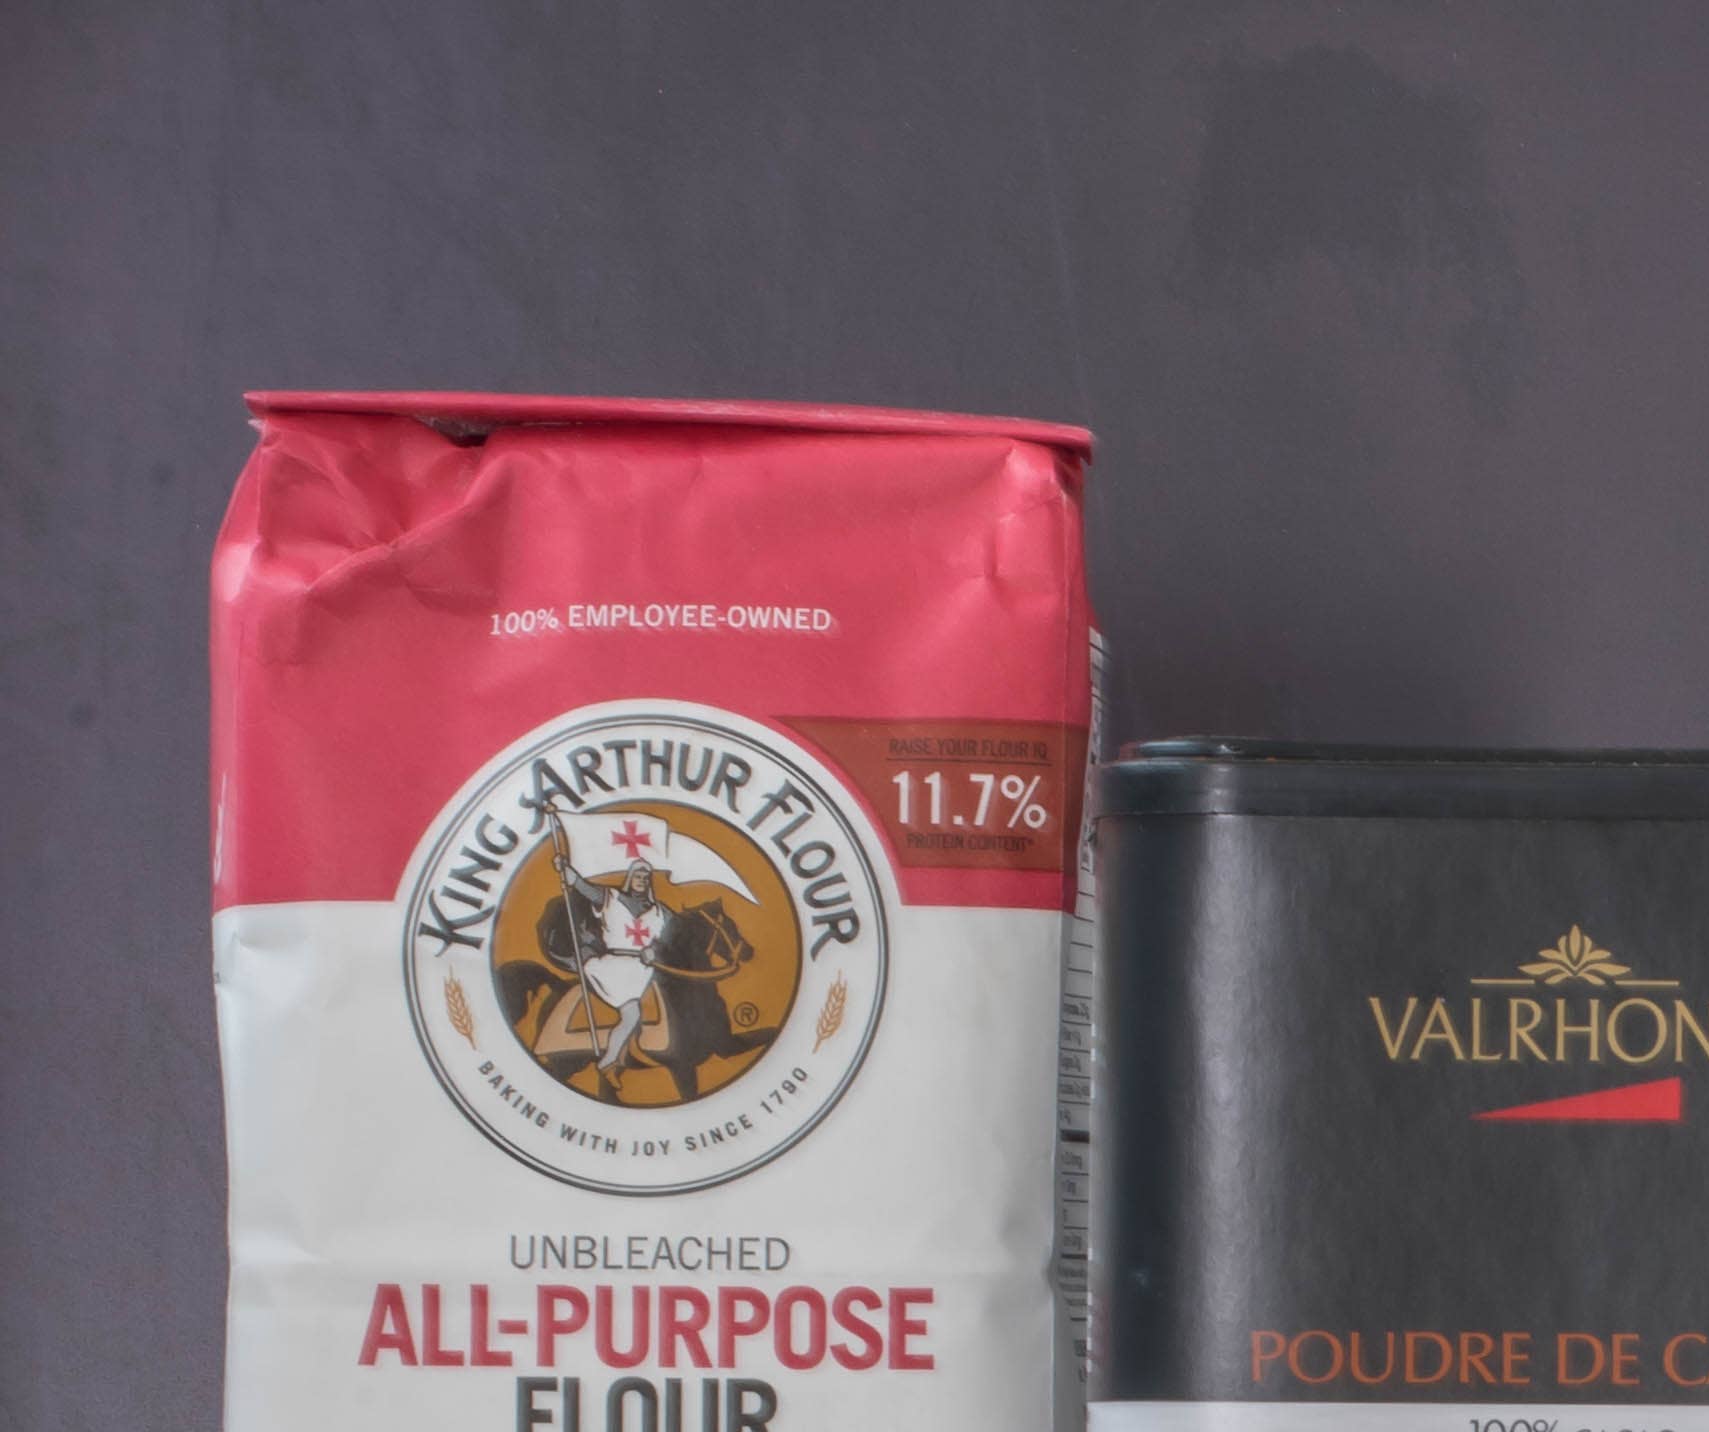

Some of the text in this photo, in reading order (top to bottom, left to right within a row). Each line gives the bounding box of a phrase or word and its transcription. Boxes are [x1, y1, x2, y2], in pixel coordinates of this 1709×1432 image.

[490, 605, 832, 636] 100% EMPLOYEE-OWNED
[892, 771, 1047, 829] 11.7%
[418, 738, 860, 962] KING ARTHUR FLOUR
[477, 1059, 811, 1158] BAKING WITH JOY SINCE 1790
[510, 1235, 791, 1271] UNBLEACHED
[358, 1283, 937, 1371] ALL-PURPOSE
[1250, 1331, 1531, 1385] POUDRE
[1556, 1333, 1639, 1385] DE
